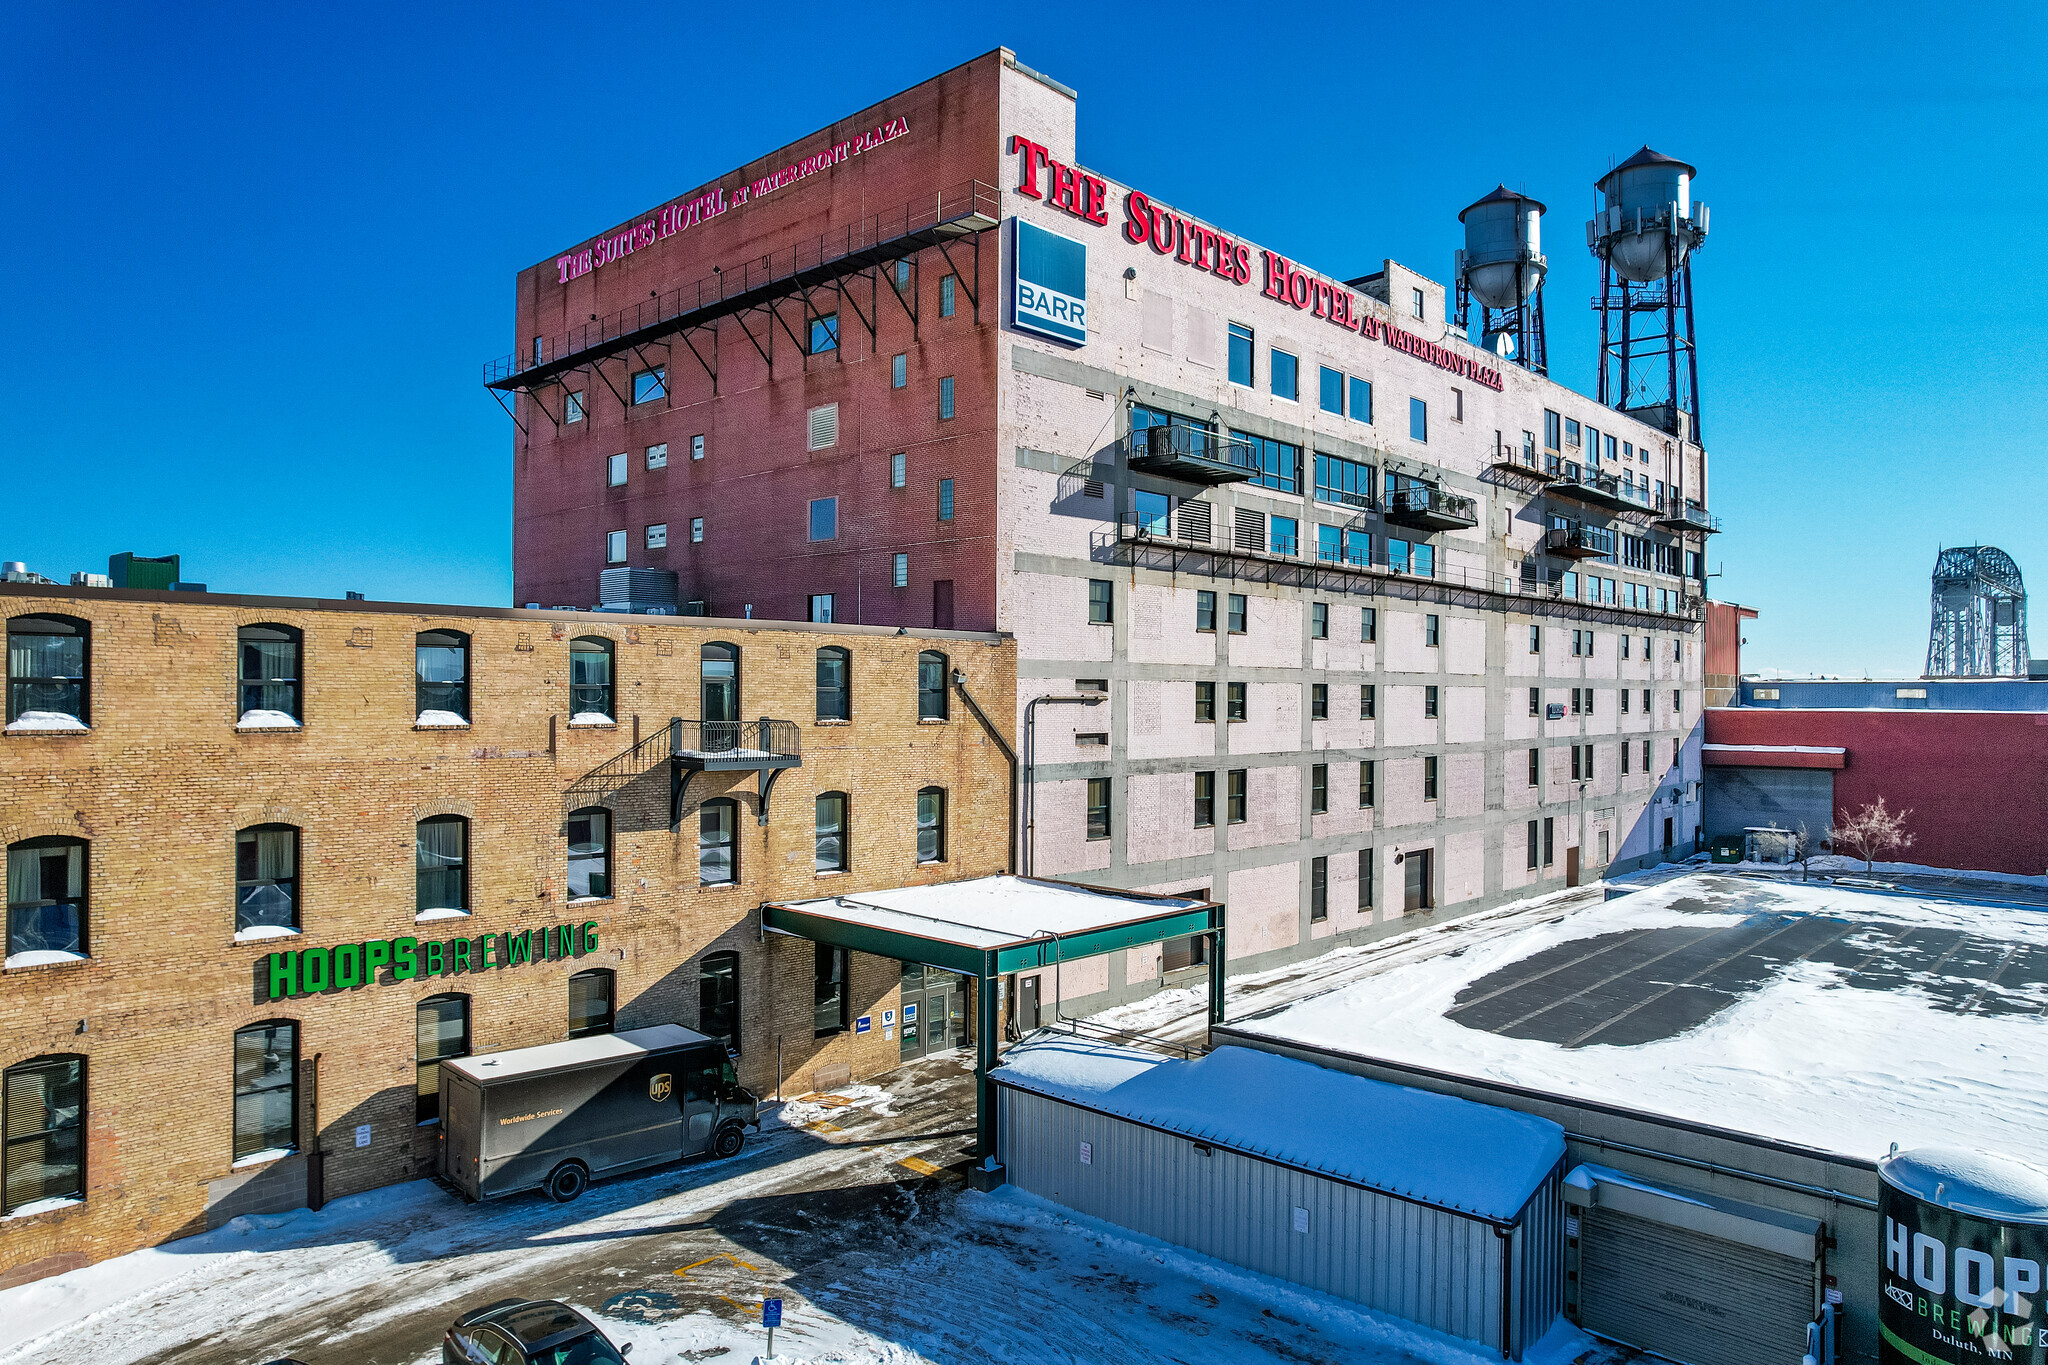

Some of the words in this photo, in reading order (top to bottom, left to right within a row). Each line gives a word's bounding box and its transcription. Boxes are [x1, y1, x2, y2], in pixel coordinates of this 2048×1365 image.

[556, 249, 593, 284] THE
[594, 219, 656, 268] SUITES
[657, 188, 727, 240] HOTEL
[731, 186, 750, 208] AT
[751, 141, 850, 198] WATERFRONT
[852, 116, 910, 156] PLAZA
[1011, 134, 1109, 226] THE
[1126, 190, 1251, 285] SUITES
[1263, 250, 1360, 333] HOTEL
[1362, 315, 1383, 341] AT
[1383, 323, 1468, 377] WATERFRONT
[1467, 359, 1505, 393] PLAZA
[1018, 284, 1085, 326] BARR
[269, 936, 418, 998] HOOPS
[427, 921, 599, 976] BREWING
[651, 1081, 670, 1098] ups
[500, 1113, 535, 1126] Worldwide
[536, 1107, 563, 1119] Services
[1886, 1215, 2048, 1316] HOOP
[1918, 1297, 2033, 1346] BREWING
[1932, 1328, 1982, 1355] Duluth,
[1988, 1347, 2014, 1361] MN
